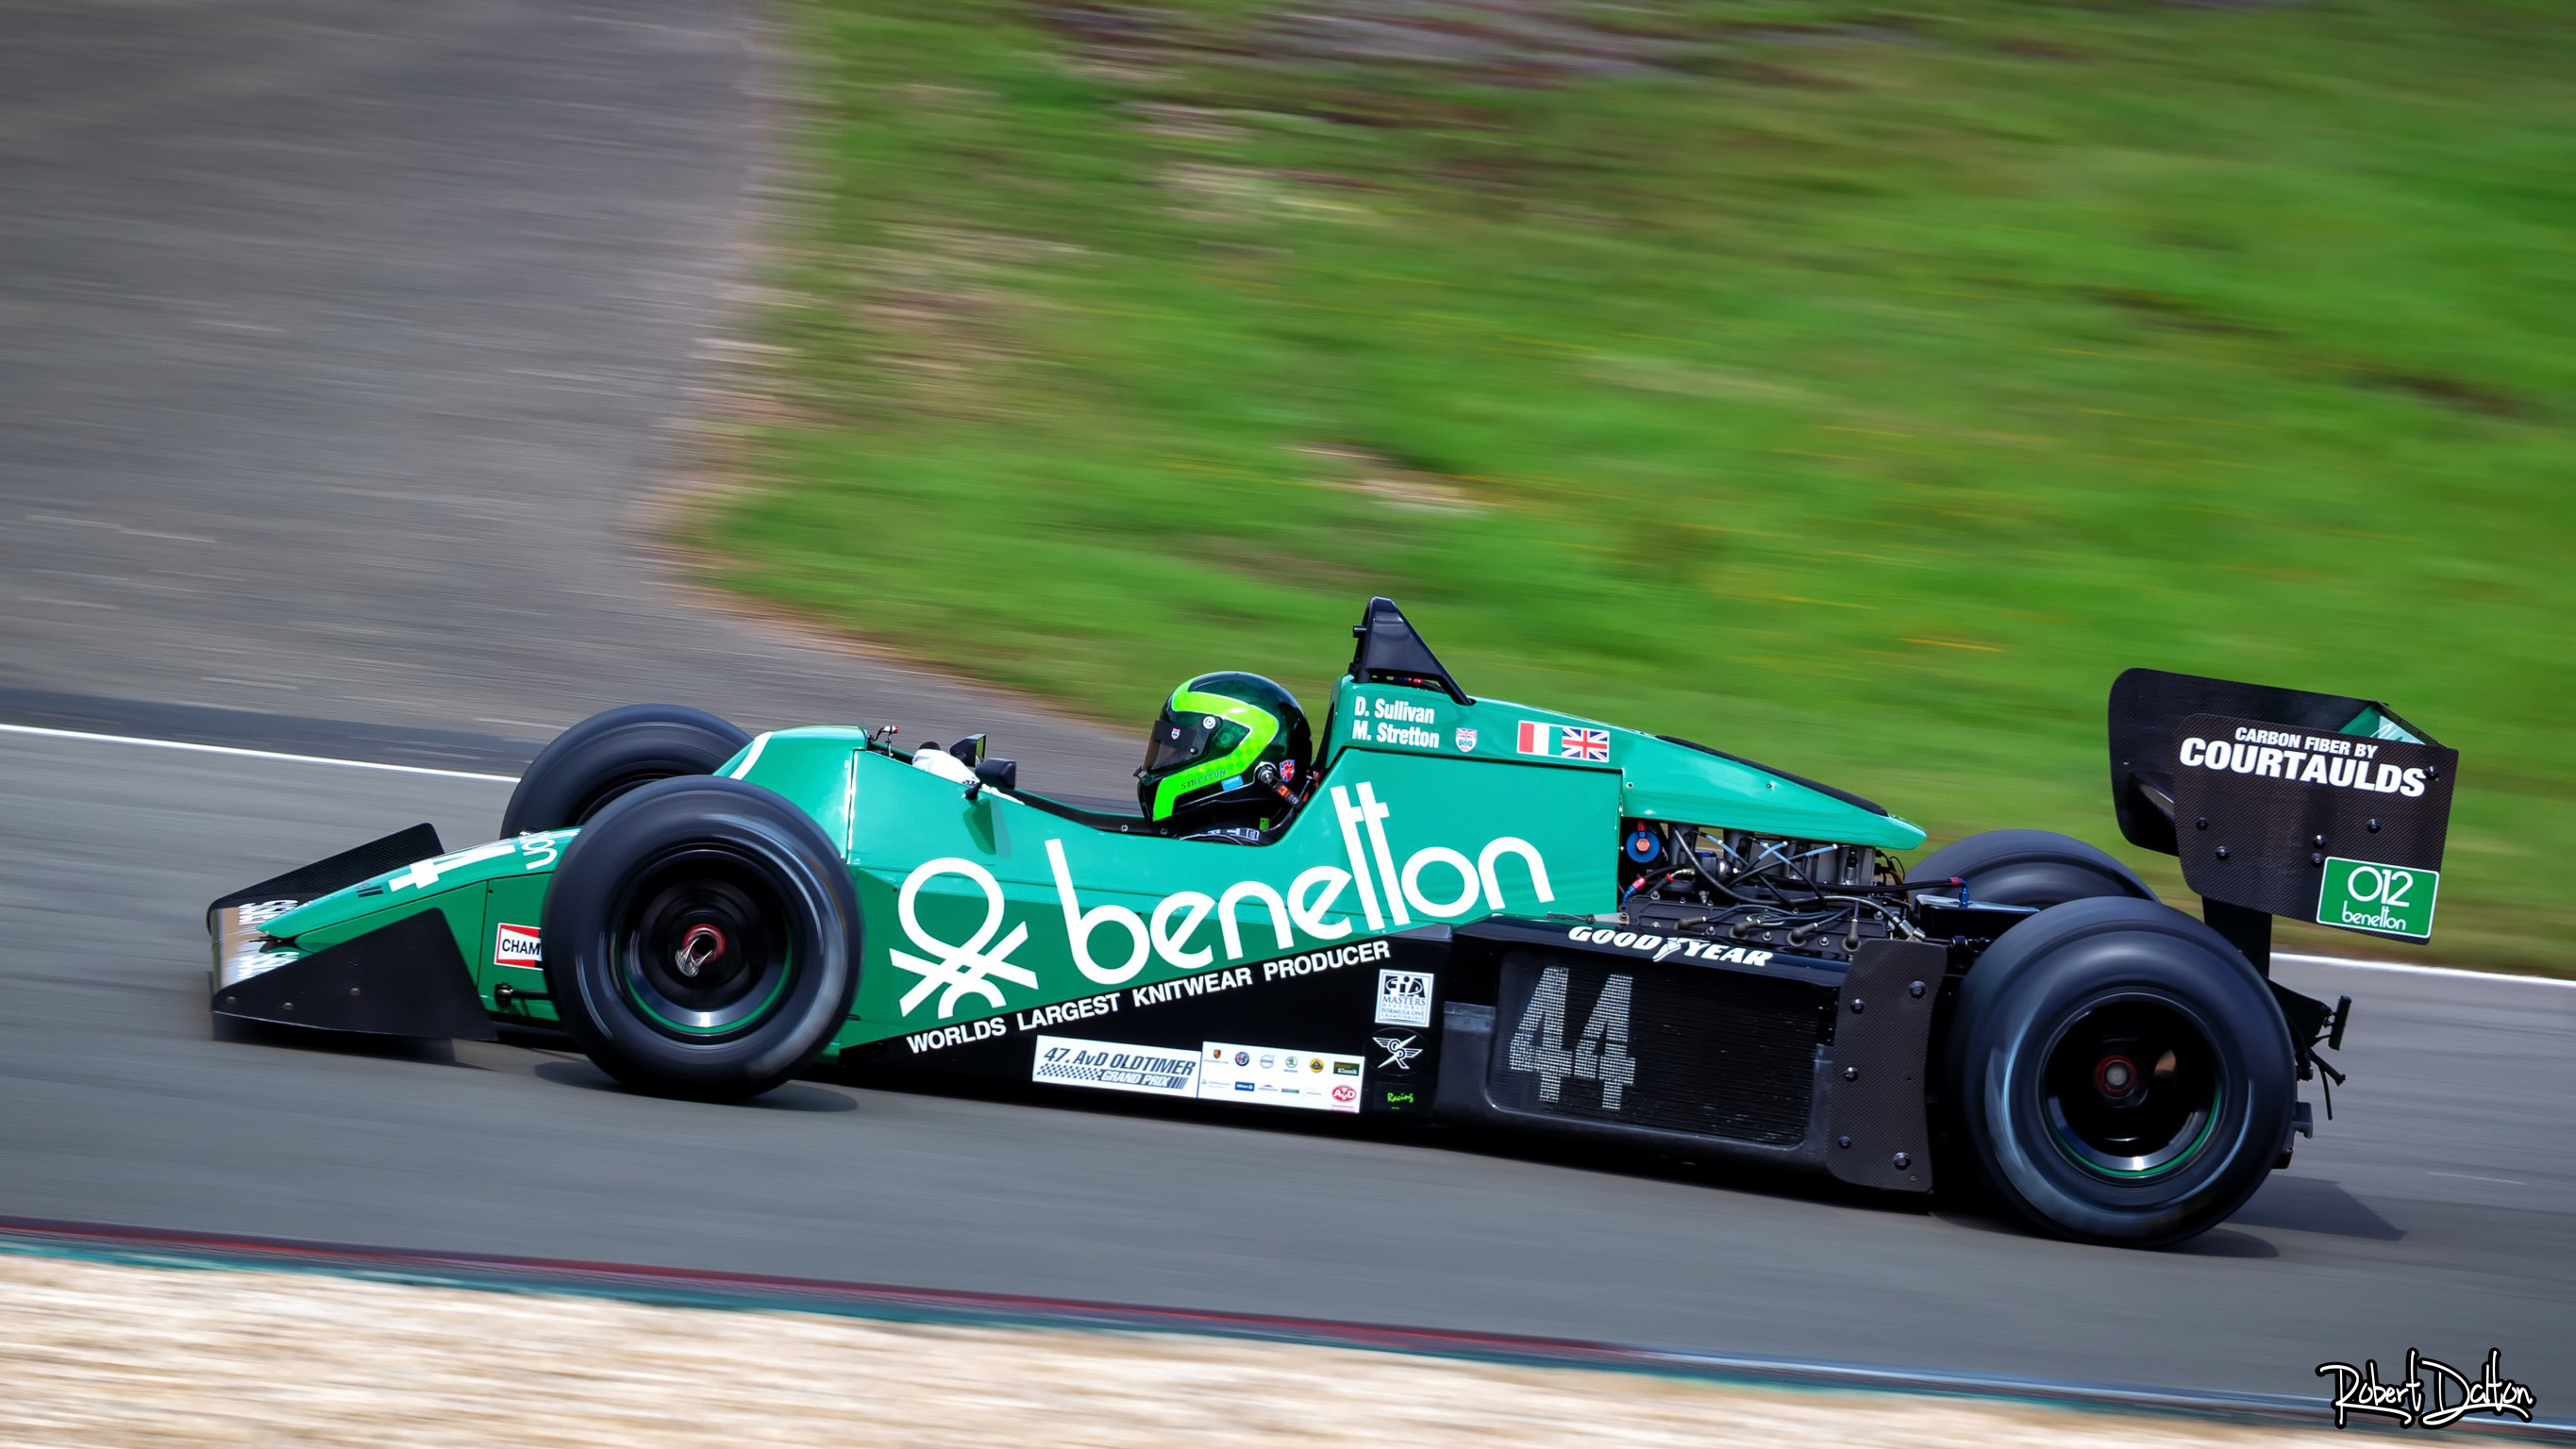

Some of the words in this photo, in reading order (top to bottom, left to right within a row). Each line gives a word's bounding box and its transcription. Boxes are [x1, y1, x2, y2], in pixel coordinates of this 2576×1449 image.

[1354, 696, 1369, 717] D.
[1375, 698, 1434, 724] Sullivan
[1352, 720, 1372, 741] M.
[1377, 723, 1440, 748] Stretton
[2235, 726, 2301, 748] CARBON
[2305, 736, 2350, 756] FIBER
[2354, 743, 2379, 759] BY
[1180, 769, 1226, 790] STRETTON
[2180, 738, 2426, 797] COURTAULDS
[1045, 781, 1554, 985] benetton
[2342, 901, 2406, 931] benetton
[907, 1017, 1007, 1054] WORLDS
[1017, 992, 1121, 1031] LARGEST
[1132, 967, 1252, 1008] KNITWEAR
[1264, 941, 1391, 982] PRODUCER
[1382, 995, 1426, 1007] MASTERS
[1380, 1008, 1411, 1016] FORMULA
[1510, 965, 1635, 1110] 44
[1044, 1047, 1071, 1063] 47.
[1074, 1050, 1109, 1067] AvD
[1110, 1053, 1196, 1075] OLDTIMER
[1100, 1070, 1139, 1084] GRAND
[1140, 1074, 1172, 1088] PRIX
[1387, 1092, 1413, 1104] Racing
